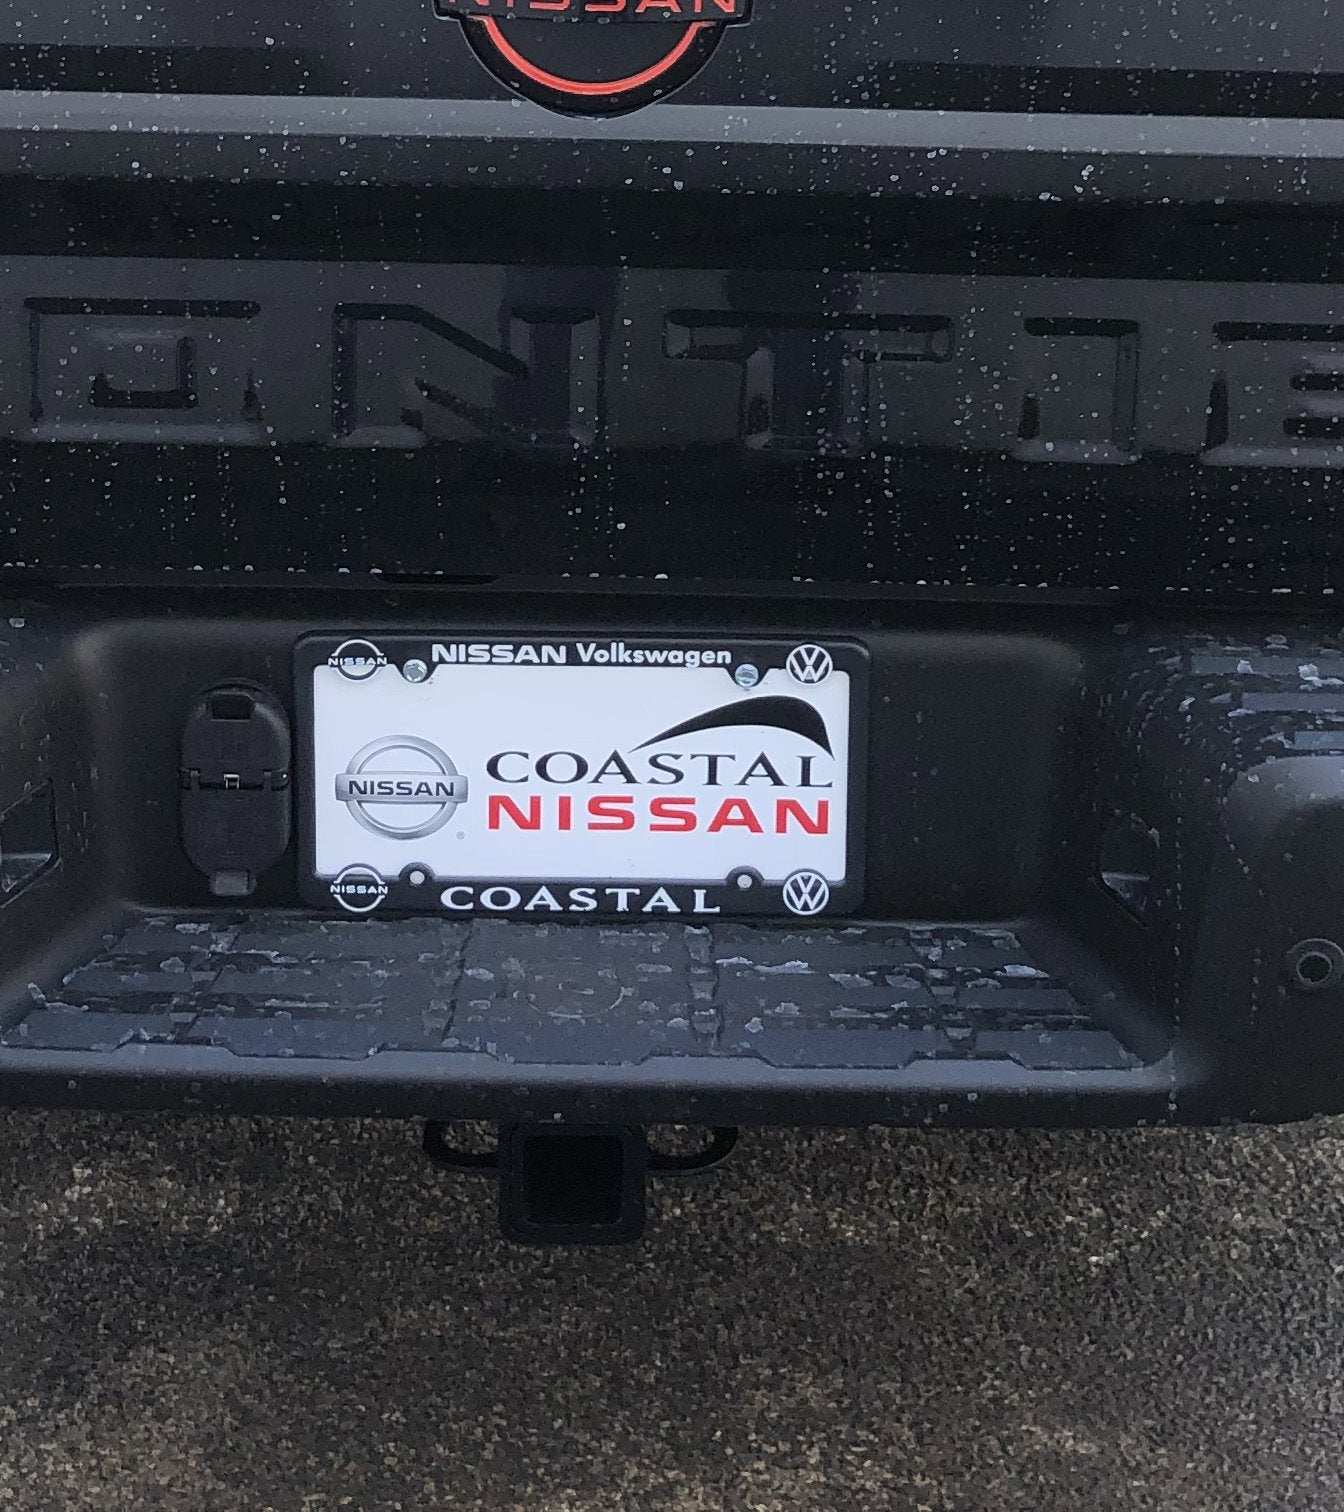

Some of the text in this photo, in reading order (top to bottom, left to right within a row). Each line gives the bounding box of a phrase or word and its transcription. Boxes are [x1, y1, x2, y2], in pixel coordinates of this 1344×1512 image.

[327, 656, 388, 666] NISSAN
[431, 641, 732, 668] NISSAN Volkswagen
[485, 748, 834, 789] COASTAL
[347, 779, 455, 799] NISSAN
[487, 794, 830, 835] NISSAN
[329, 884, 389, 895] NISSAN
[440, 885, 721, 915] COASTAL
